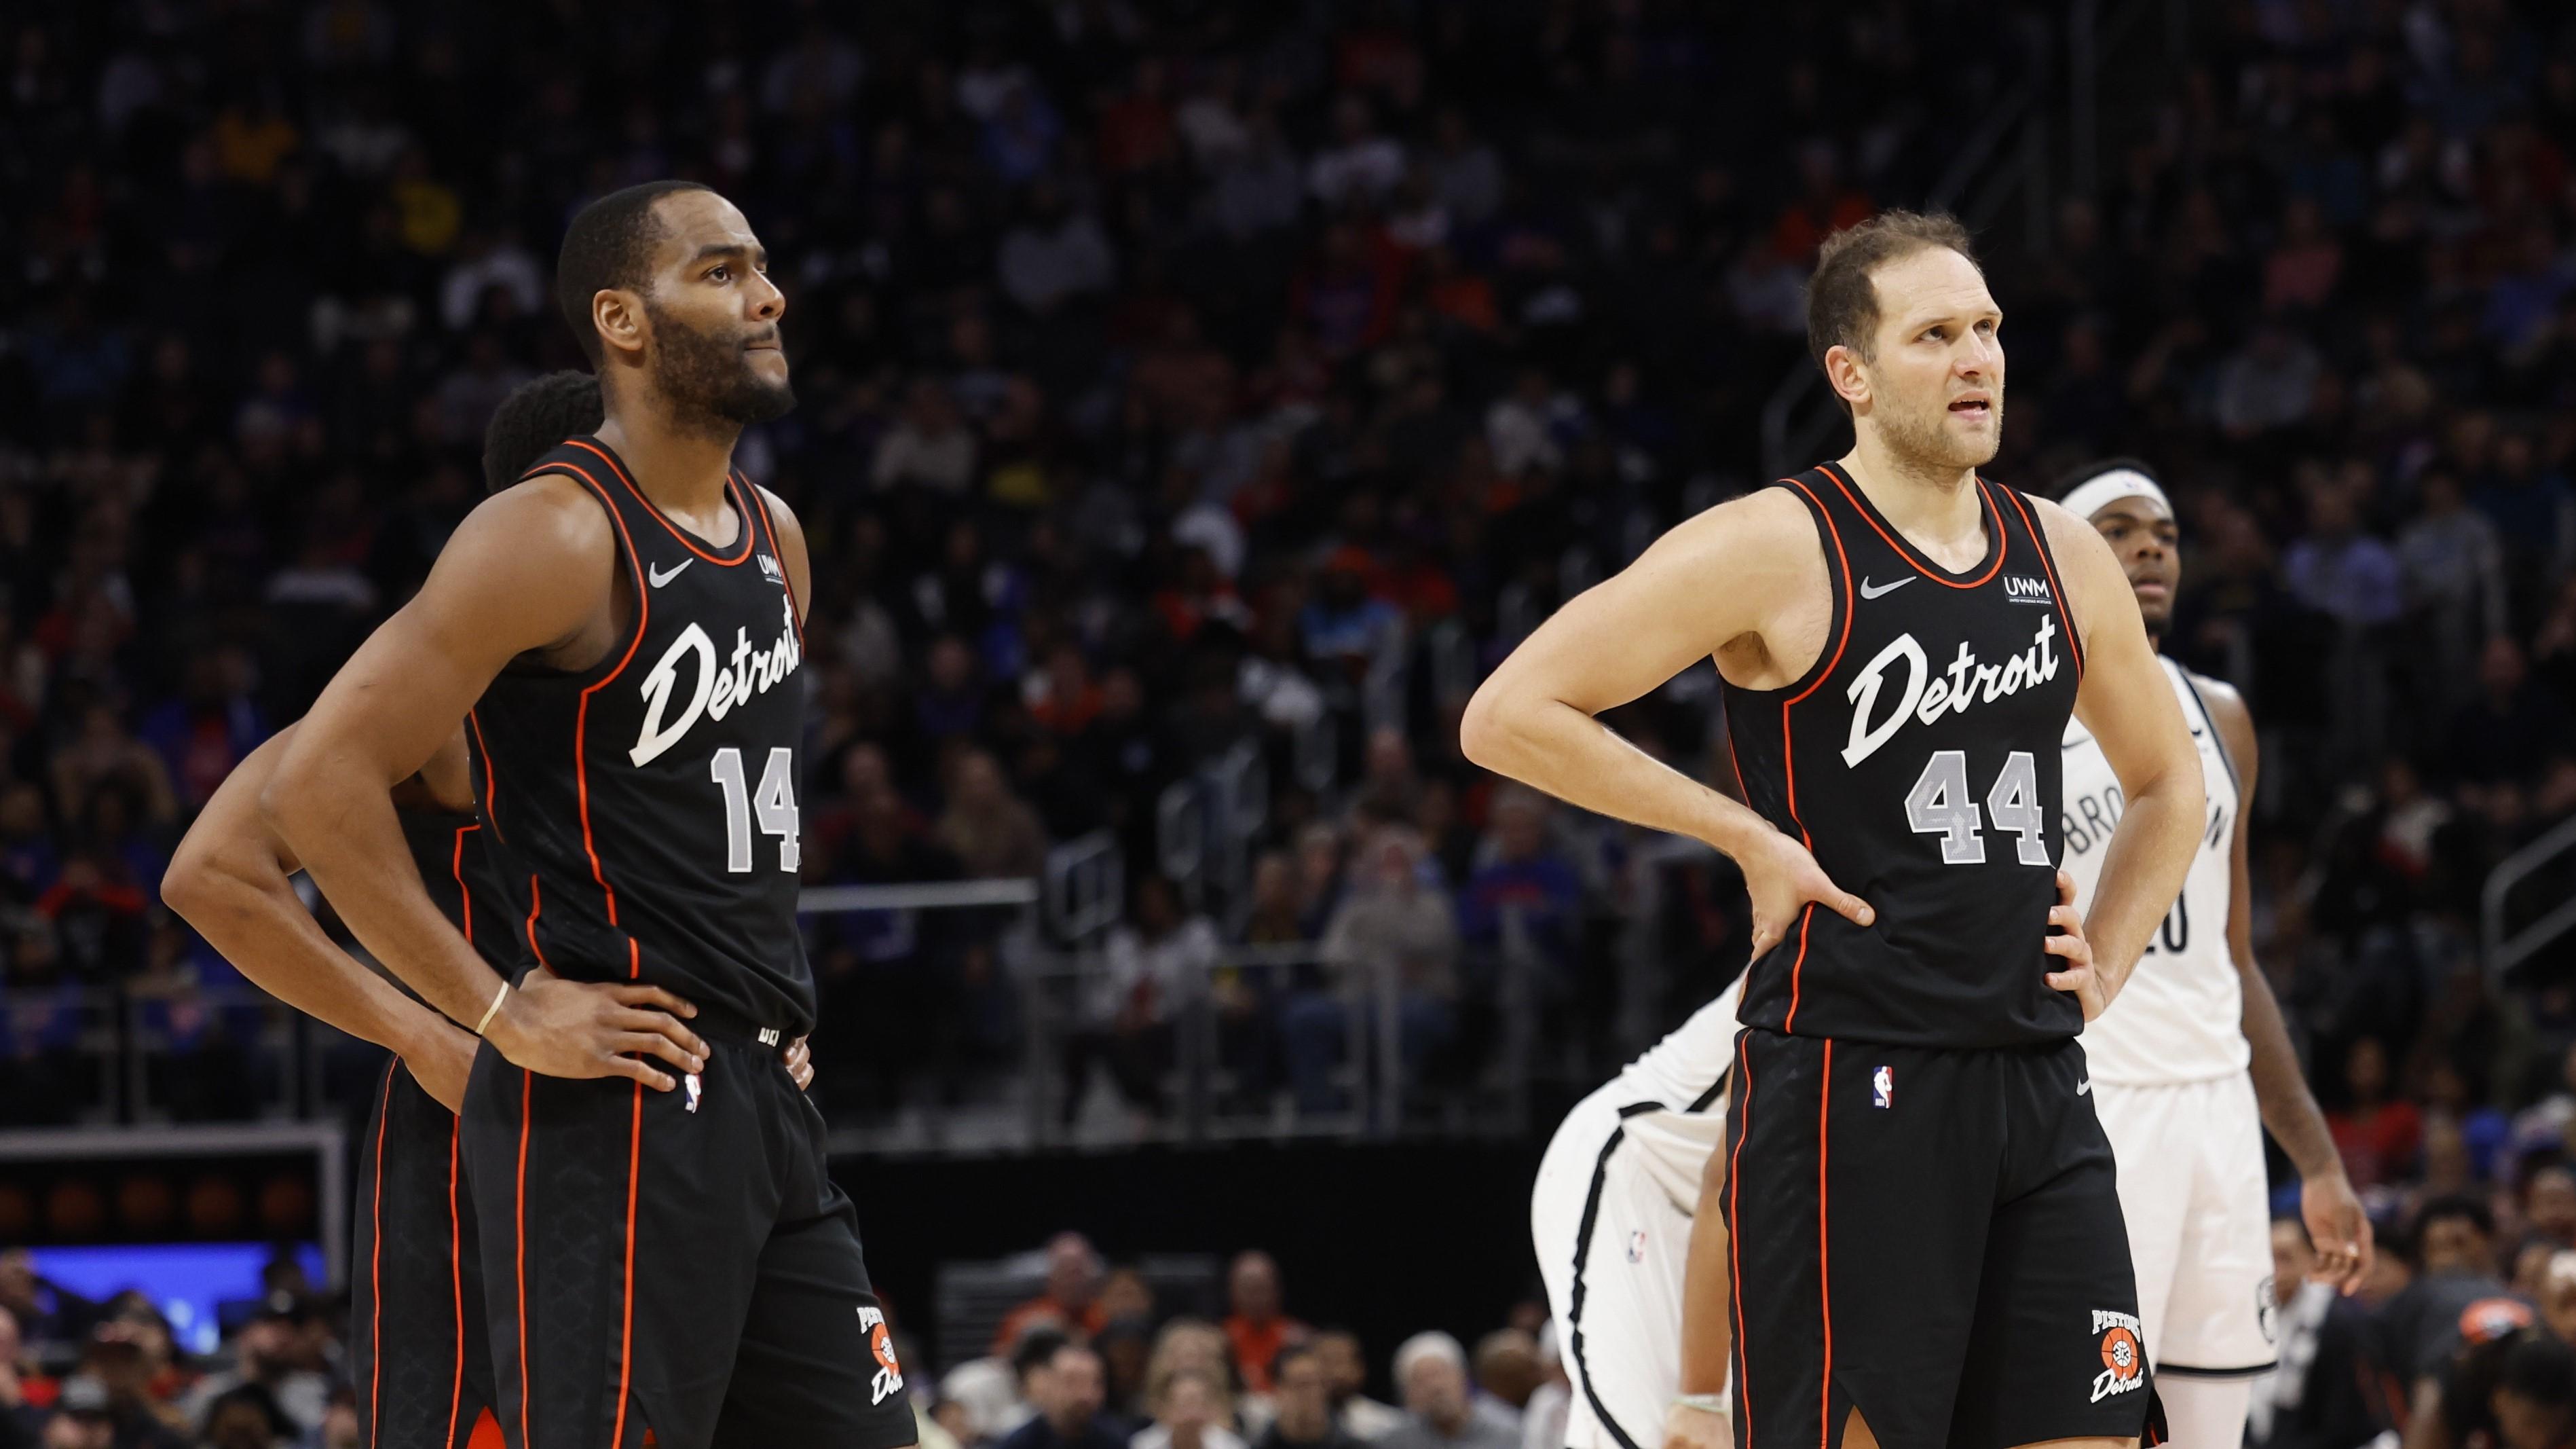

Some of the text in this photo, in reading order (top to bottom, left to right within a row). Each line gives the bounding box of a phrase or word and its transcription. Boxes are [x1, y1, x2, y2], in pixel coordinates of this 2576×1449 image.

[2004, 576, 2050, 598] UWM
[629, 593, 800, 768] Detroit
[1840, 614, 2059, 769] Detroit
[710, 747, 800, 873] 14
[1905, 750, 2051, 866] 44
[2091, 1310, 2141, 1344] PISTONS
[2090, 1367, 2144, 1404] Detroit
